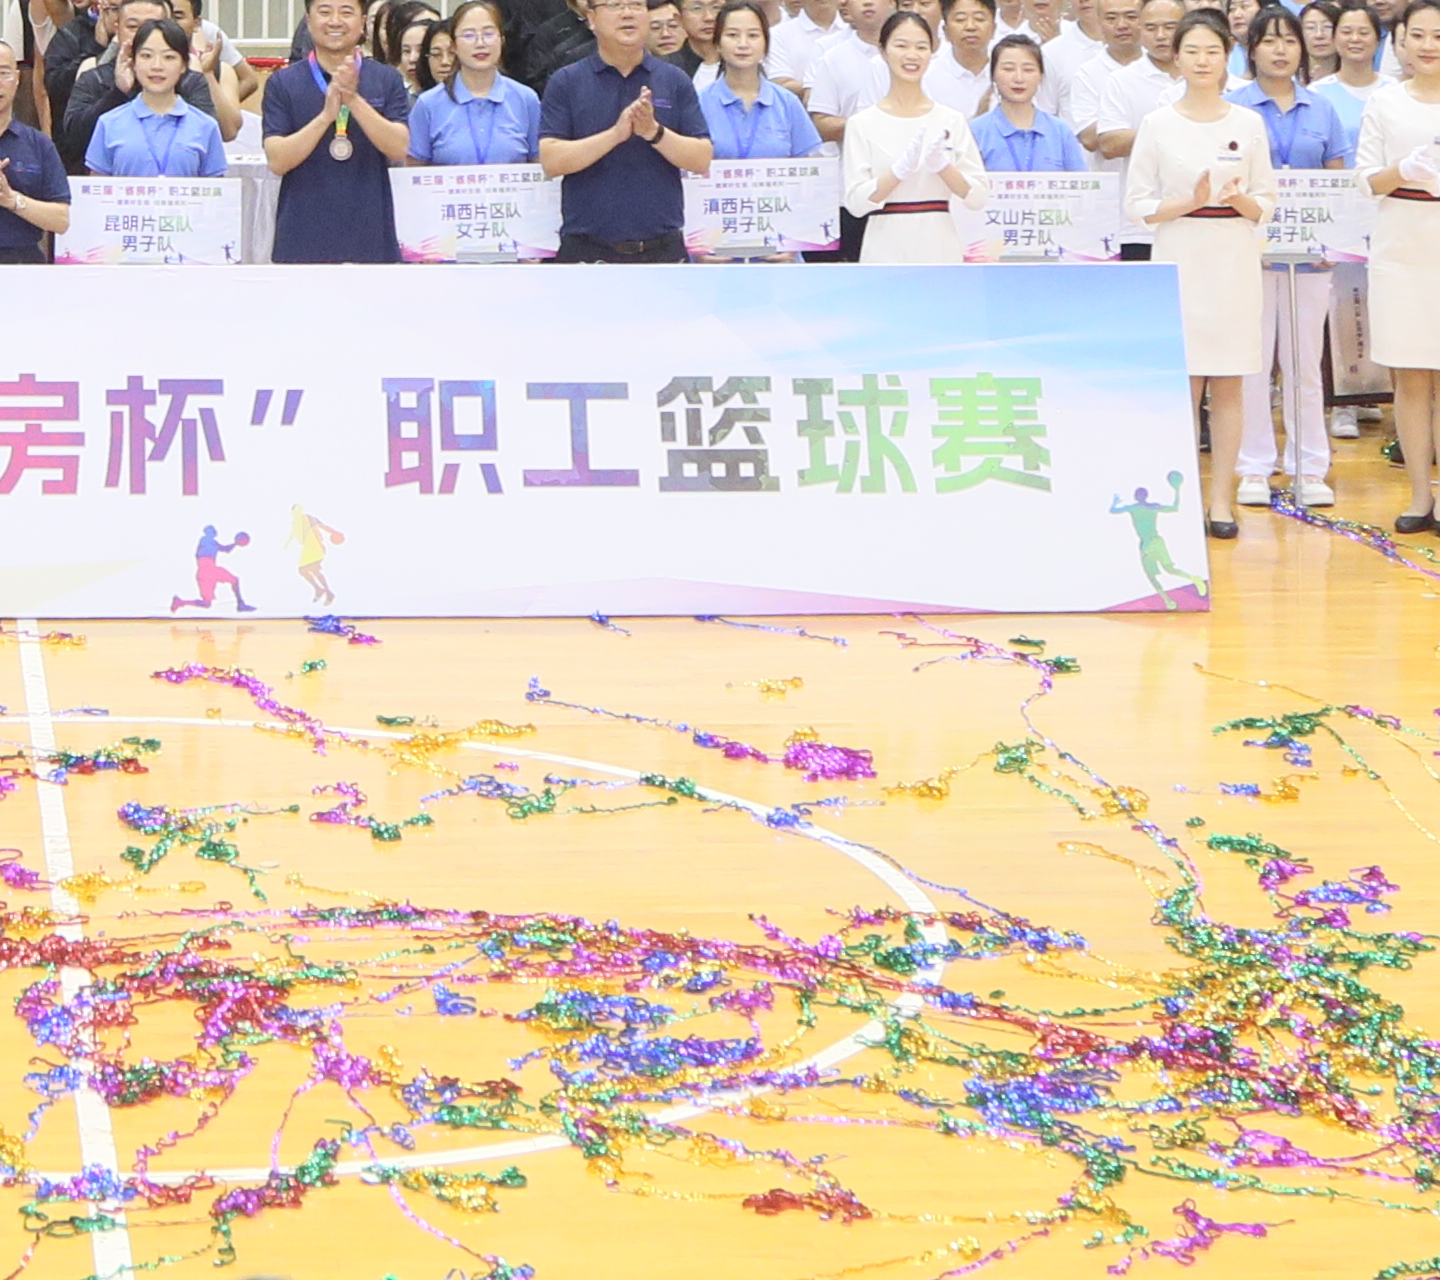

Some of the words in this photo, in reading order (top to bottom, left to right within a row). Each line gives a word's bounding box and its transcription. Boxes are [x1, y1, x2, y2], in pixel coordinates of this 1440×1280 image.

[440, 202, 522, 222] 滇西片区队
[702, 196, 793, 216] 滇西片区队
[103, 214, 194, 233] 昆明片区队
[721, 215, 775, 234] 男子队
[984, 208, 1073, 227] 文山片区队
[456, 222, 509, 239] 女子队
[1002, 229, 1056, 247] 男子队
[1266, 226, 1318, 243] 男子队
[121, 234, 175, 253] 男子队
